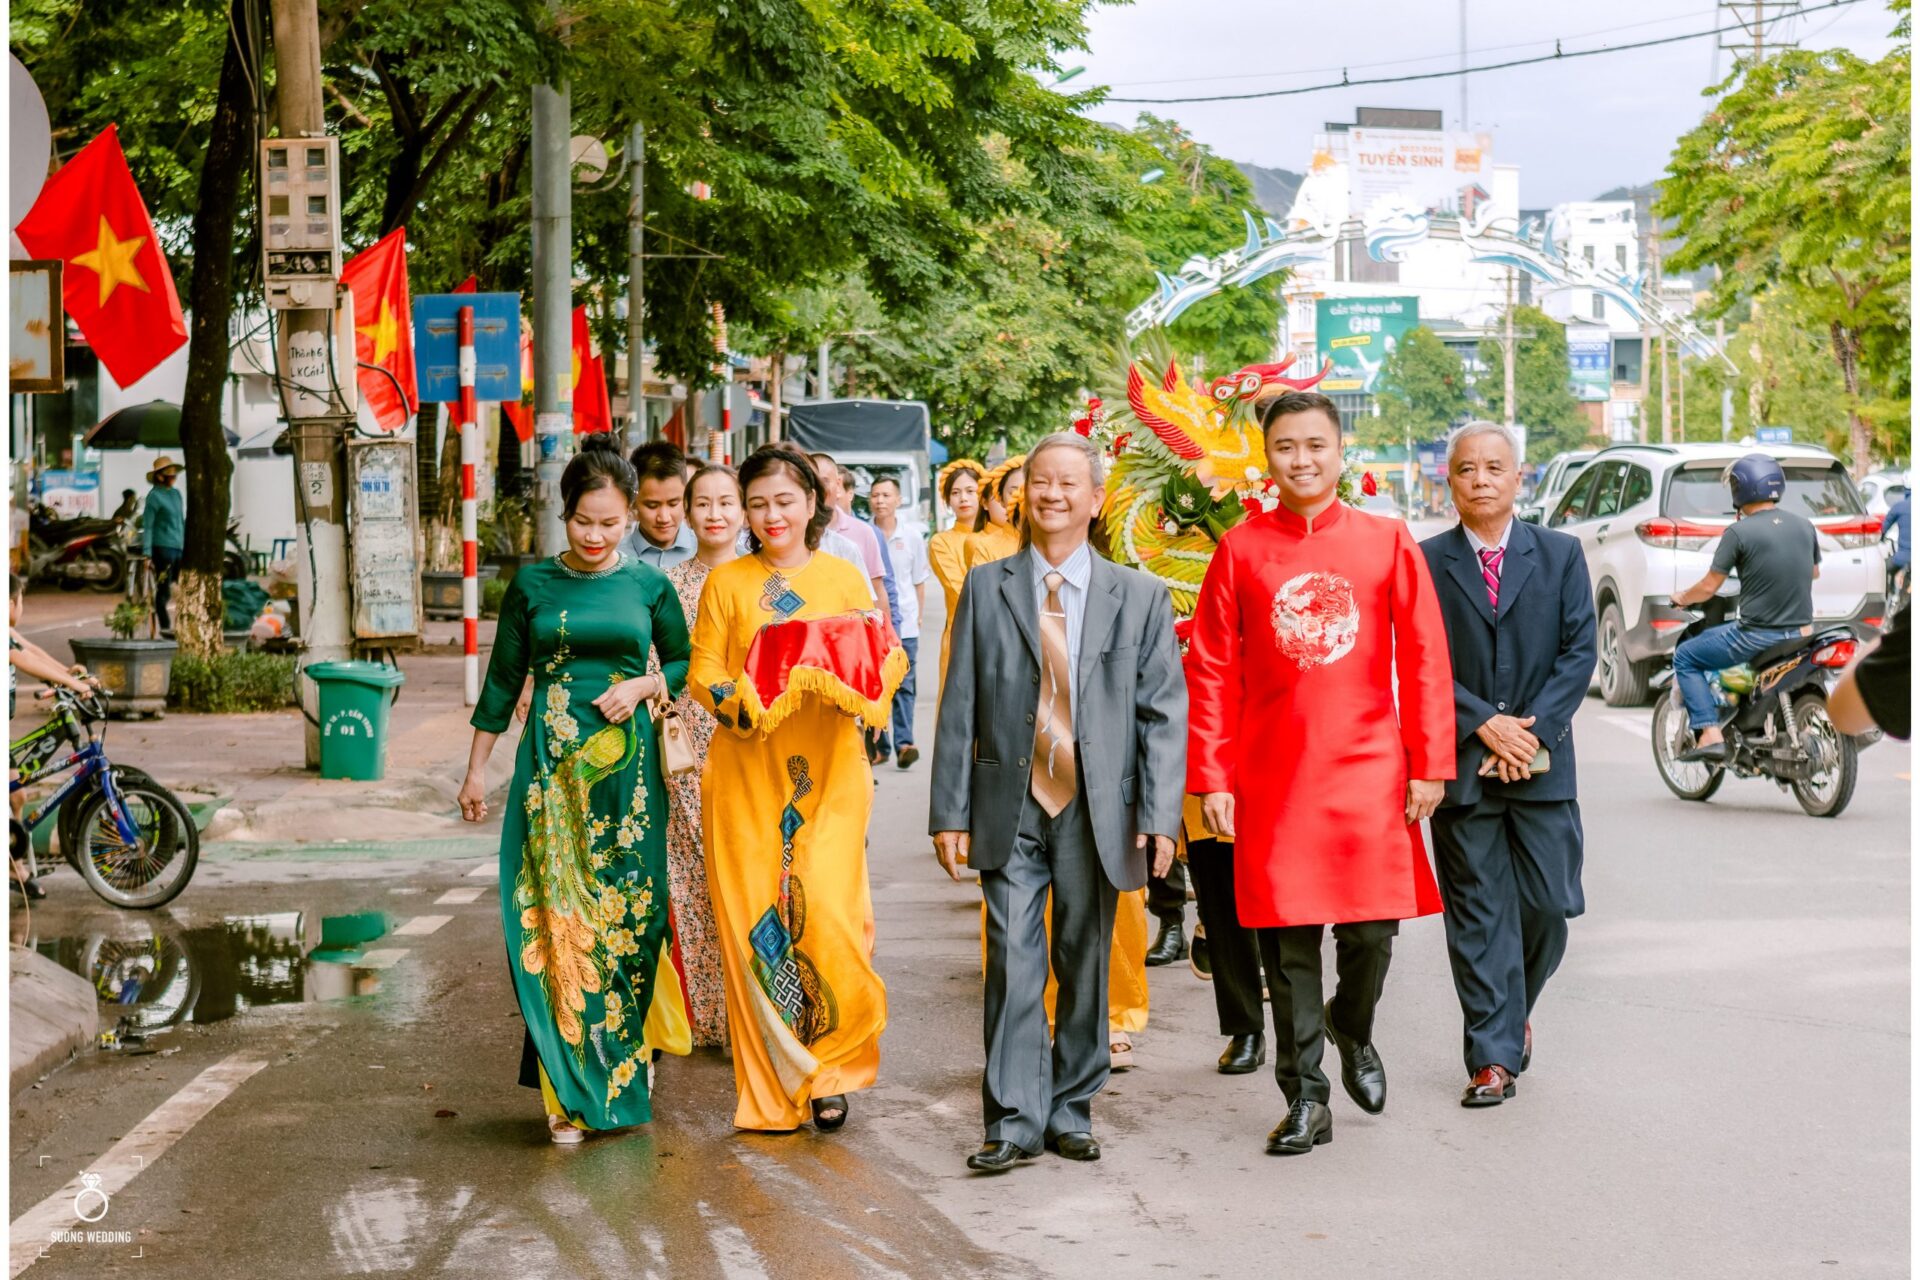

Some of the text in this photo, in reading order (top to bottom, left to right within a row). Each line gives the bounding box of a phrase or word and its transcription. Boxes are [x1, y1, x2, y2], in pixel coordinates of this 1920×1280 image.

[1358, 148, 1407, 167] TUYỂN
[1411, 153, 1444, 168] SINH
[340, 725, 355, 736] 01
